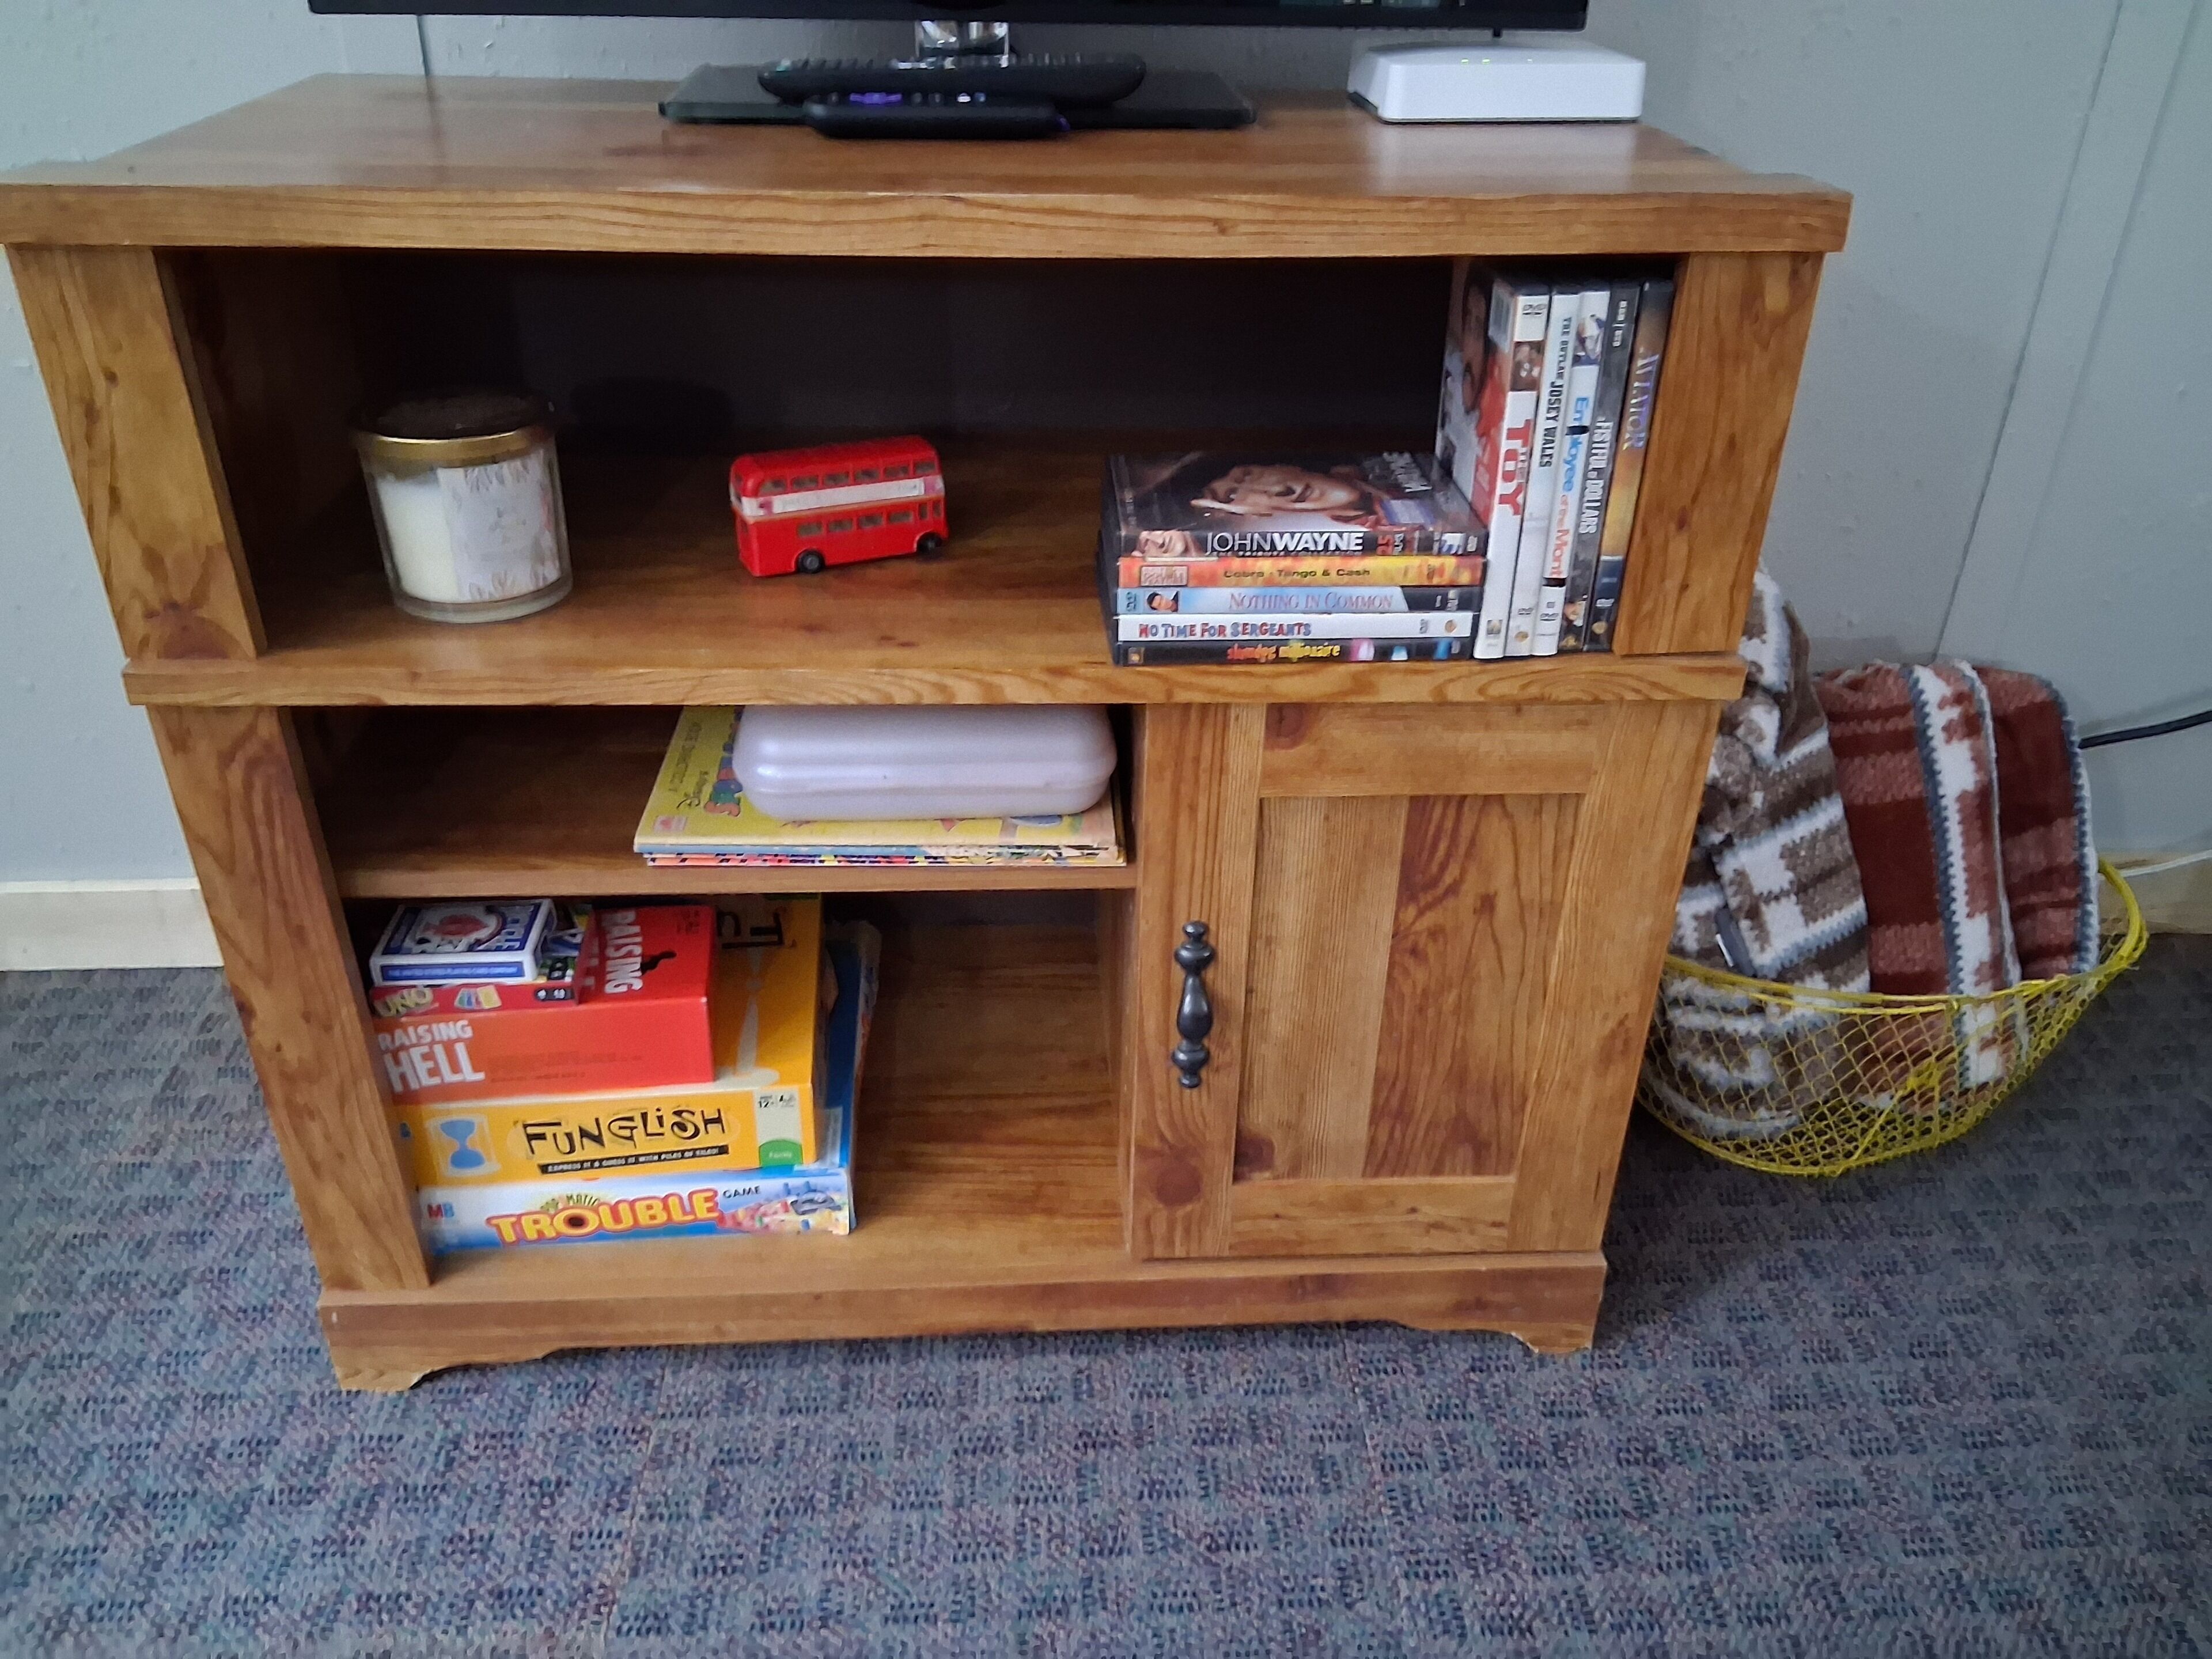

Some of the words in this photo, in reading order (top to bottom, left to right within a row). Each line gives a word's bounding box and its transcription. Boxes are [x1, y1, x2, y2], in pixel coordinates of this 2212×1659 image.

[1546, 381, 1564, 422] JOSEY
[1539, 426, 1558, 467] WALES
[1563, 396, 1589, 492] Emloyee
[1589, 422, 1613, 469] FISTFUL
[1498, 419, 1532, 516] TOY
[1578, 479, 1604, 534] DOLLARS
[1229, 593, 1300, 609] NOTHING
[1304, 594, 1321, 609] IN
[1325, 592, 1394, 609] COMMON
[1139, 624, 1160, 638] NO
[1161, 623, 1196, 638] TIME
[1200, 622, 1226, 638] FOR
[1230, 622, 1312, 638] SERGEANTS
[601, 910, 643, 994] RAISING
[375, 987, 433, 1018] UNO
[378, 1020, 474, 1051] RAISING
[383, 1041, 486, 1093] HELL
[427, 1203, 454, 1218] MB
[488, 1188, 720, 1245] TROUBLE
[722, 1185, 762, 1199] GAME
